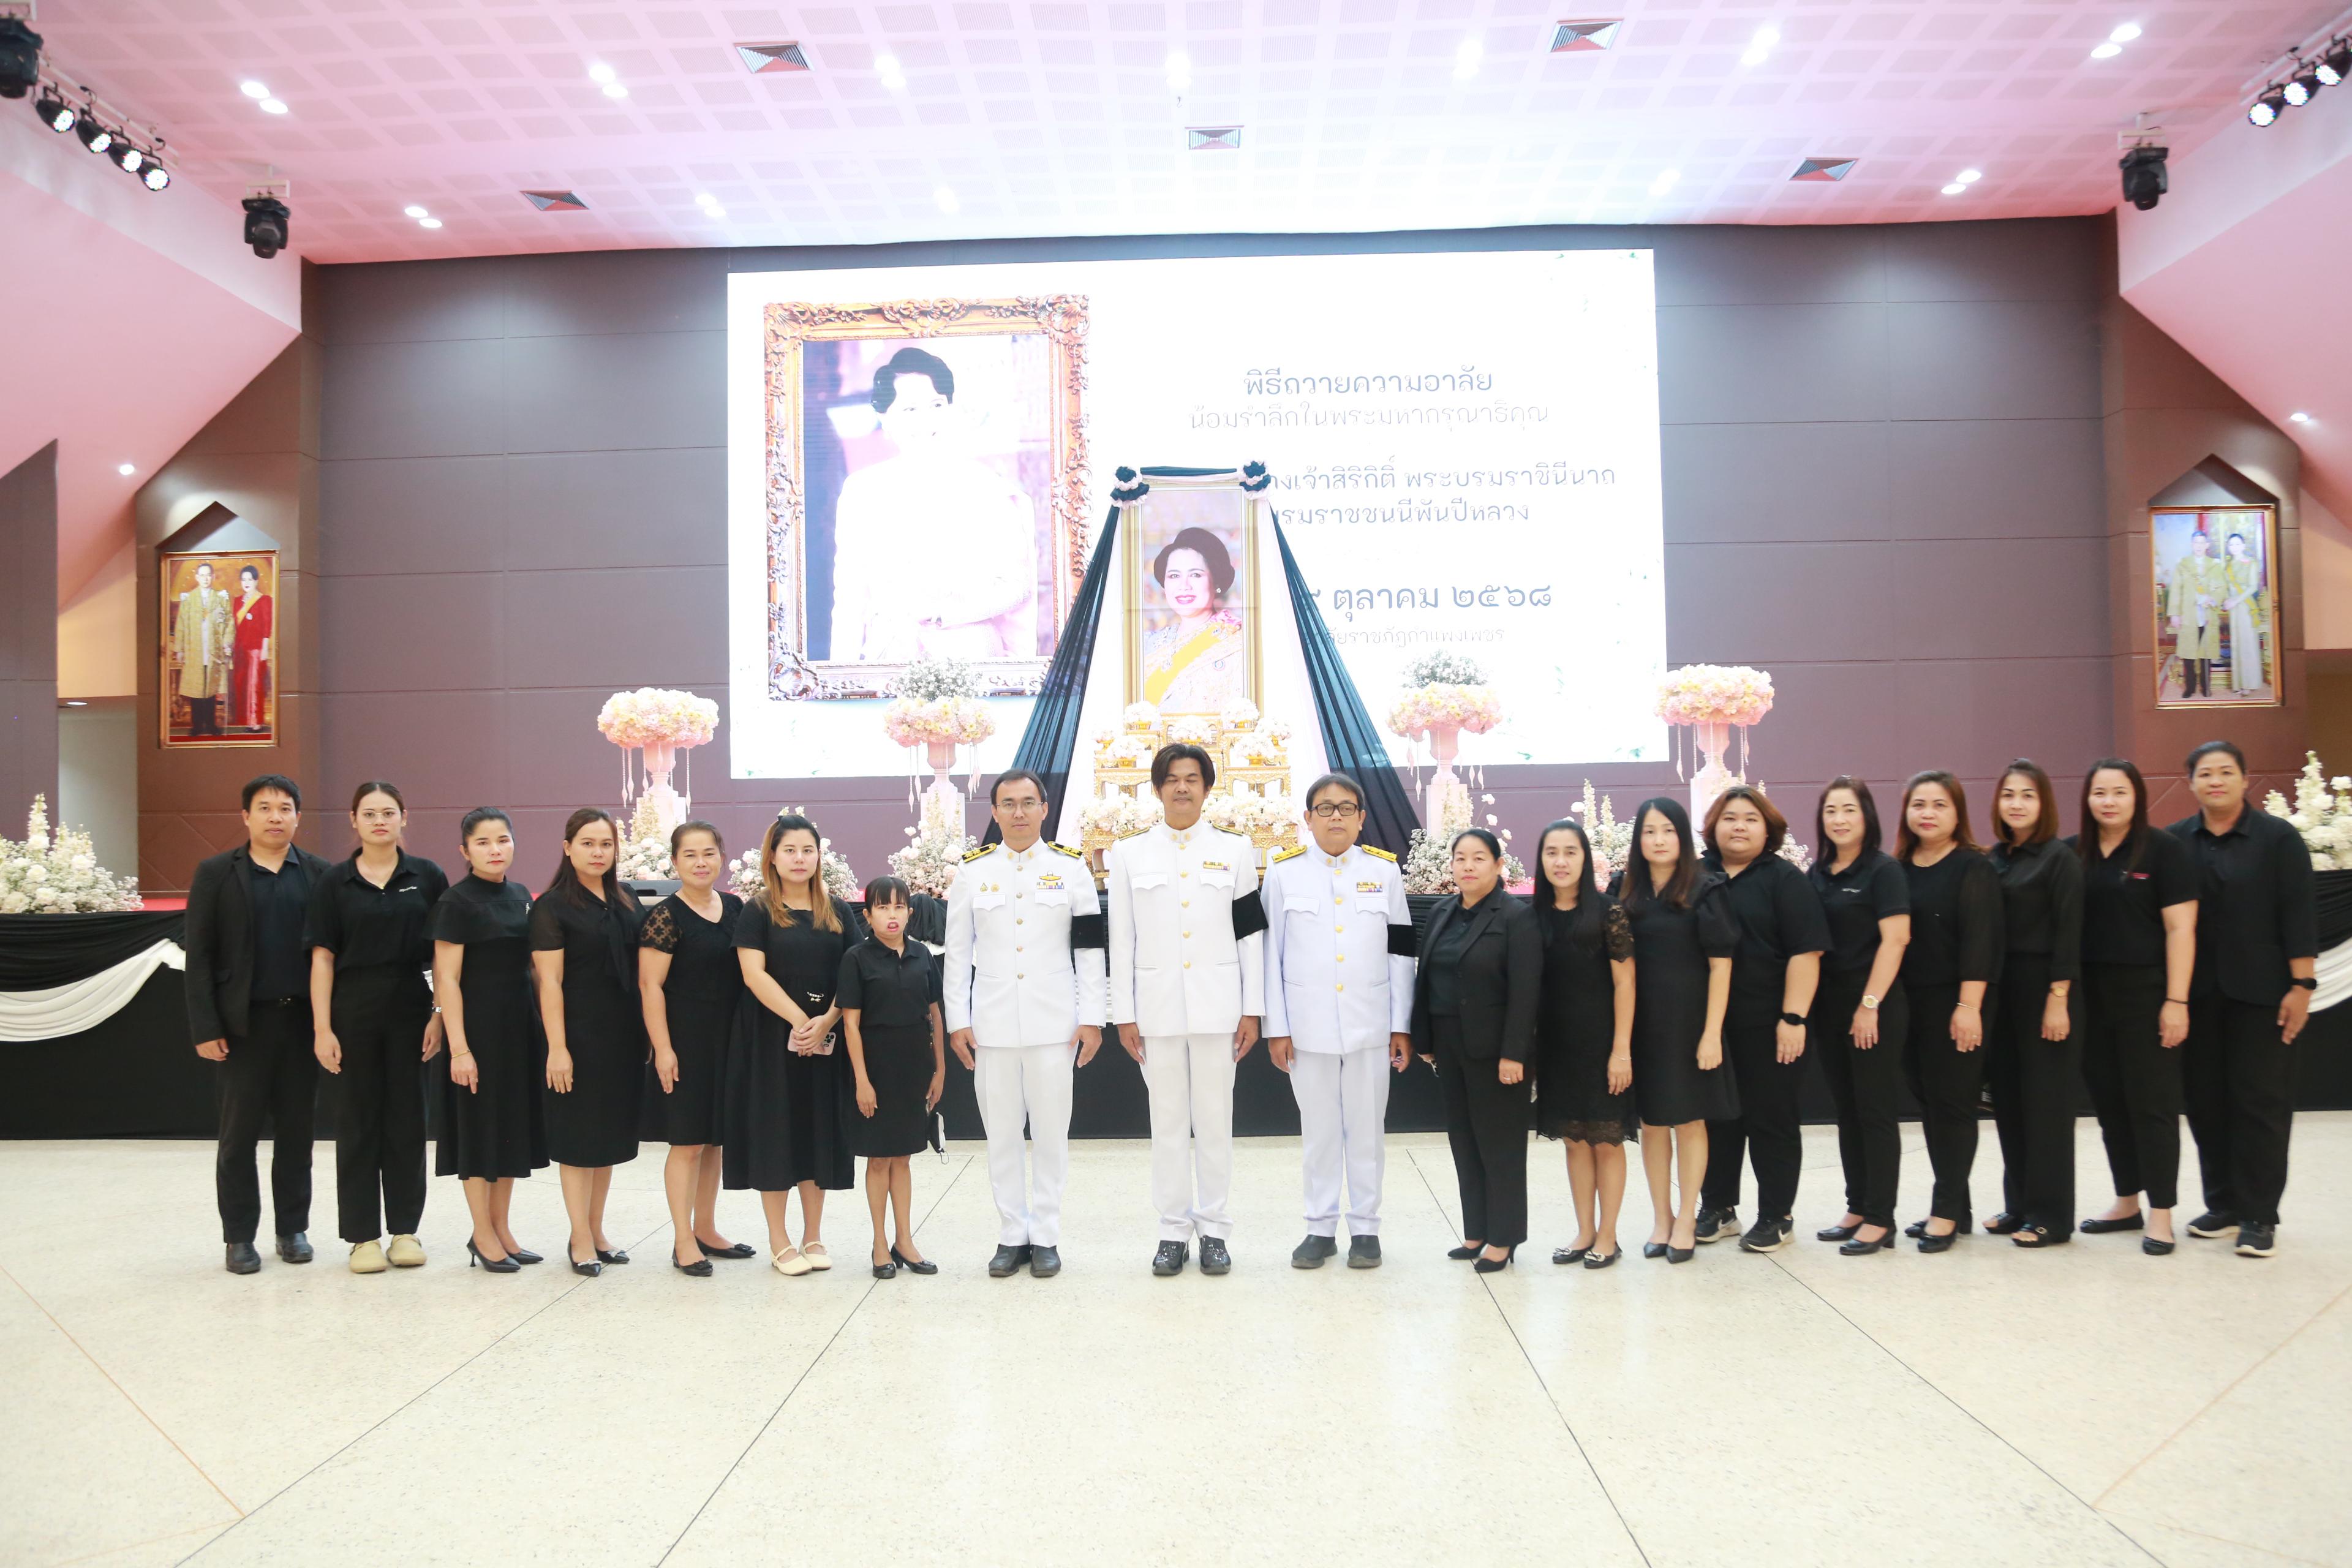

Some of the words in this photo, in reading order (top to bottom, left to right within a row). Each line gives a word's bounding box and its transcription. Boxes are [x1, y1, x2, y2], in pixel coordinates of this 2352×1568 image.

[1243, 364, 1493, 396] พิธีถวายความอาลัย
[1404, 461, 1615, 488] พระบรมราชินีนาถ
[1275, 497, 1529, 526] รมราชชนนีพันปีหลวง
[1334, 588, 1438, 622] ตุลาคม
[1451, 585, 1551, 608] ๒๕๖๘
